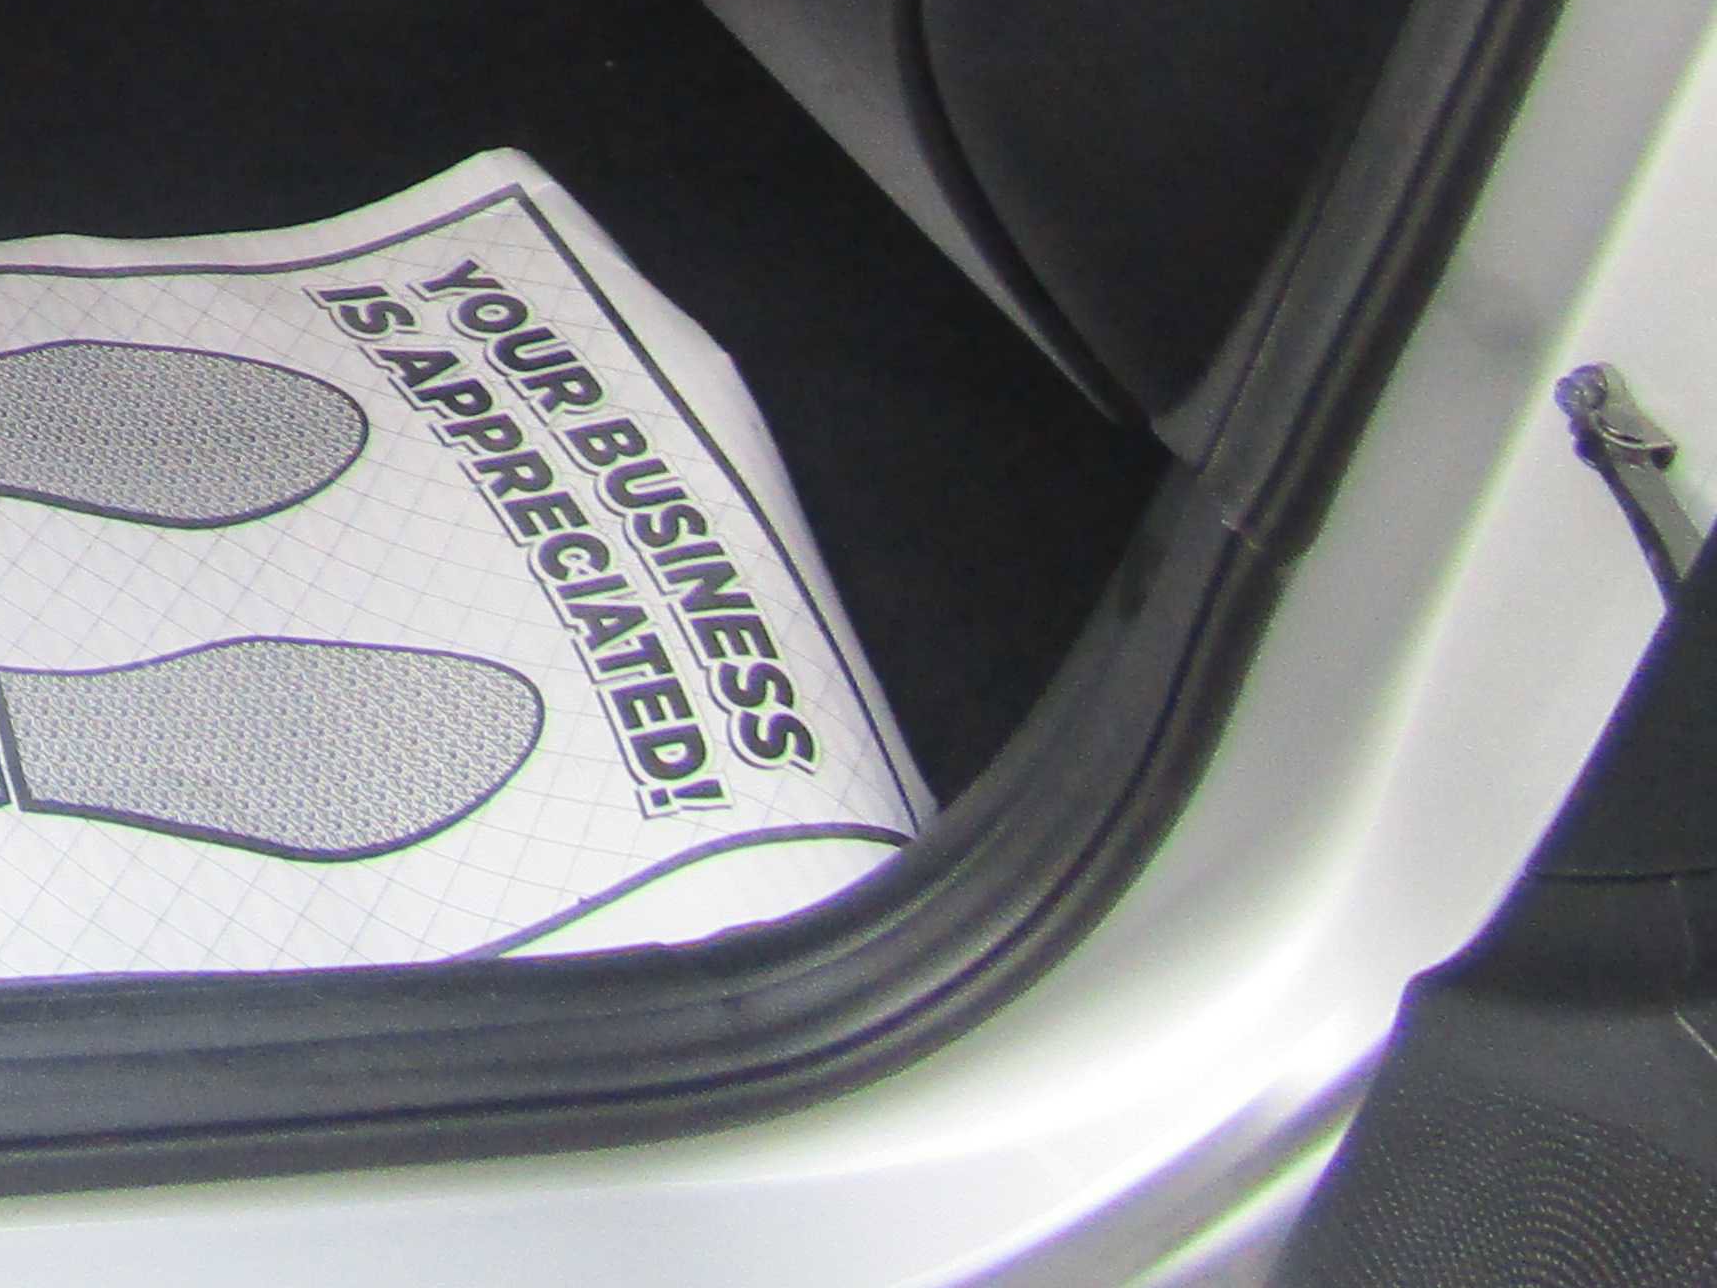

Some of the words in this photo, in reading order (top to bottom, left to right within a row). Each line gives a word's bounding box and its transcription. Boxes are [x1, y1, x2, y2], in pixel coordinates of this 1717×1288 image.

[315, 284, 418, 337] IS
[369, 348, 727, 812] APPRECIATED!
[415, 258, 605, 415] YOUR
[563, 416, 817, 768] BUSINESS
